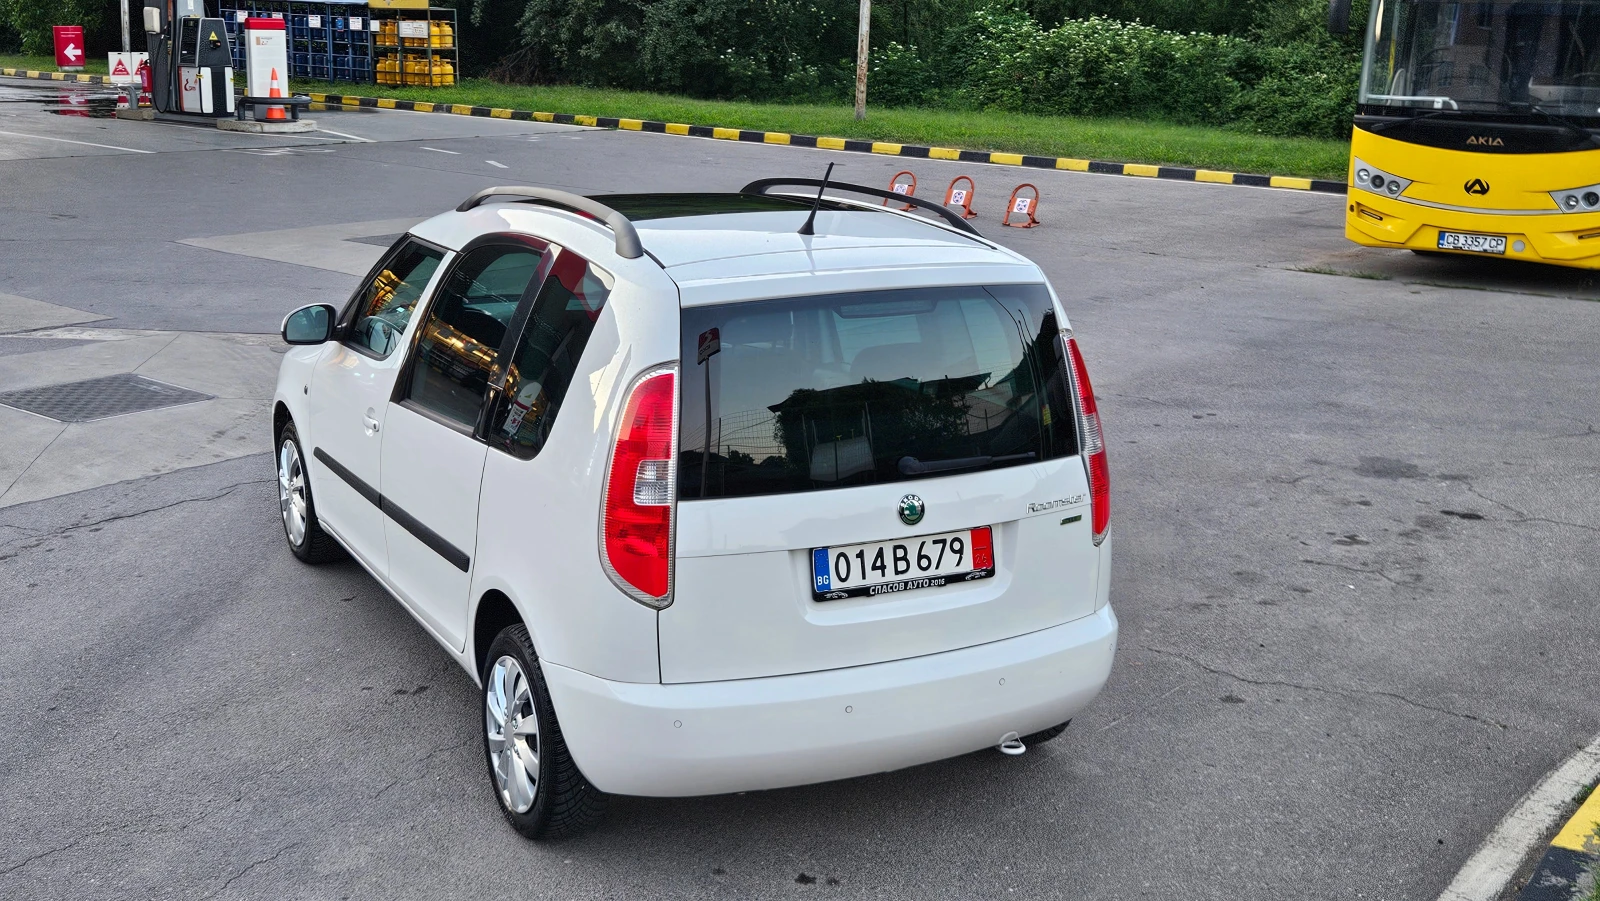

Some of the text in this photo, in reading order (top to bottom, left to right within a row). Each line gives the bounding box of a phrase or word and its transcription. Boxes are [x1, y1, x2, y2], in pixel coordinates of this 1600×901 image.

[1466, 135, 1504, 146] AKIA
[1446, 234, 1460, 246] CB
[1461, 235, 1487, 247] 3357
[1489, 238, 1504, 249] CP
[1026, 494, 1086, 514] Roomster
[817, 537, 965, 586] BG 014B679
[869, 577, 945, 596] СПАСОВ АУТО 2016
